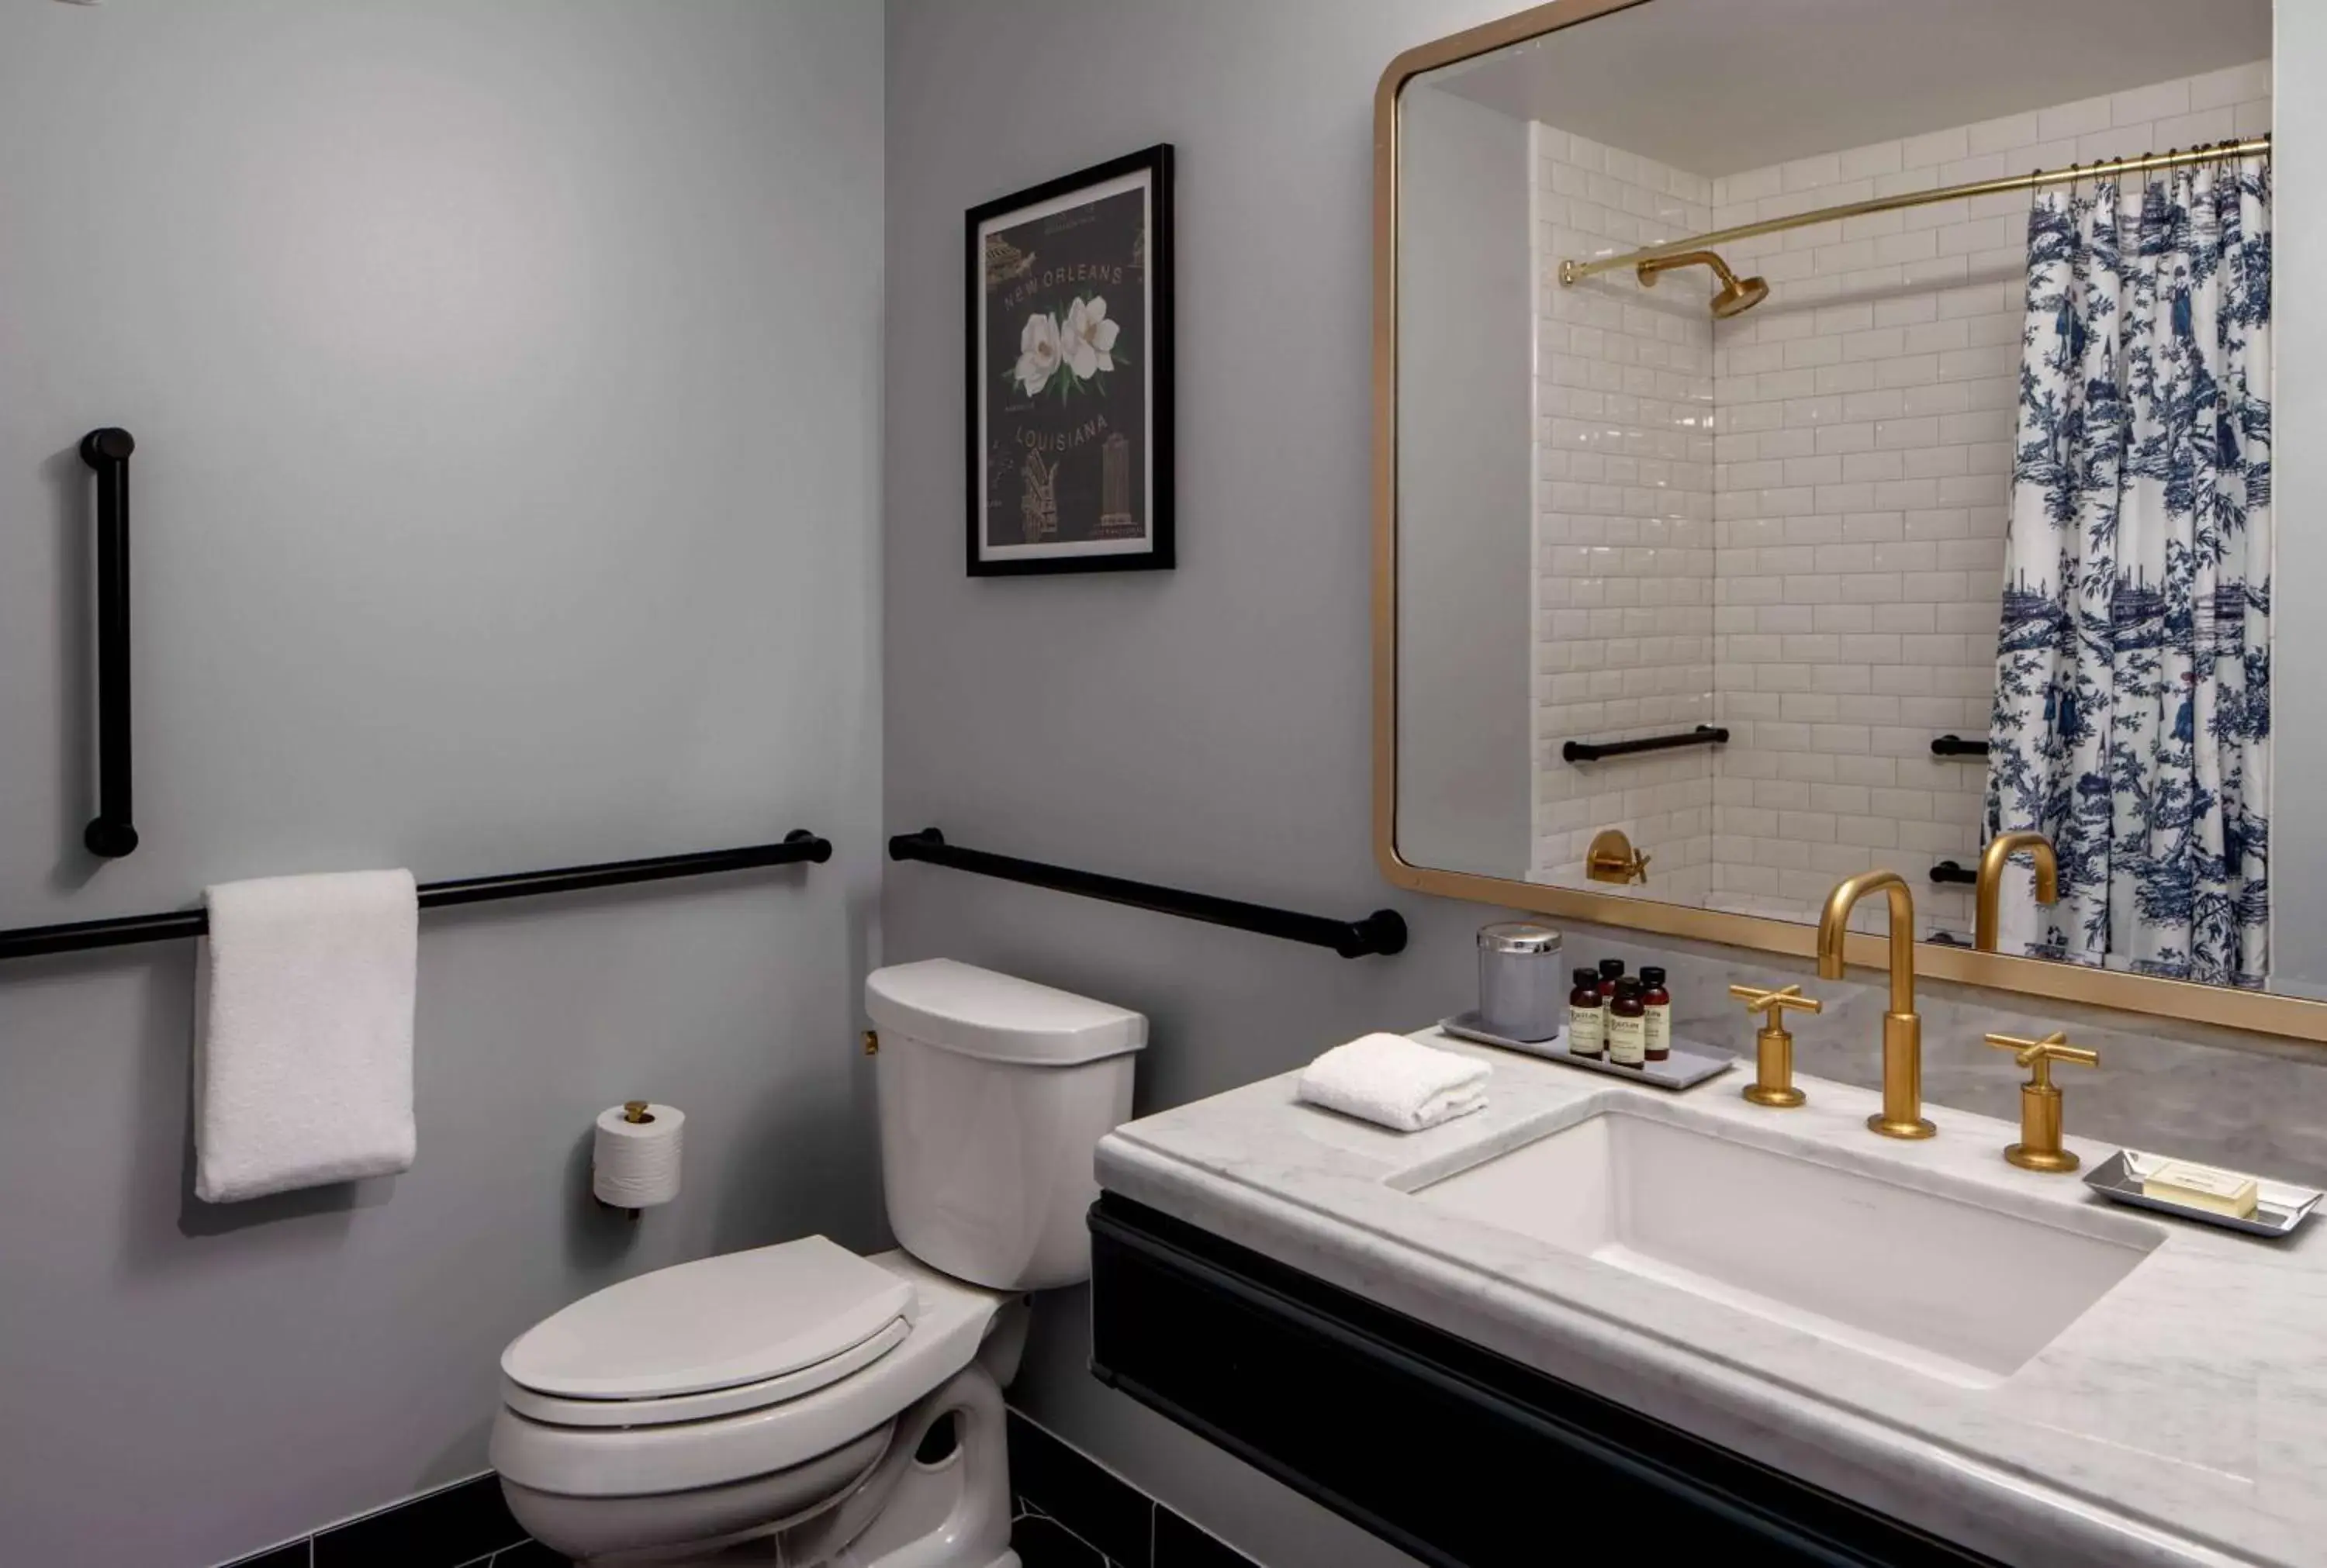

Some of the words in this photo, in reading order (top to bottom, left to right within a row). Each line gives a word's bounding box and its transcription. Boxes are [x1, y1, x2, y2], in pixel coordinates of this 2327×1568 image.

[1004, 276, 1038, 312] NEW
[1043, 263, 1123, 287] ORLEANS
[1015, 413, 1108, 452] LOUISIANA
